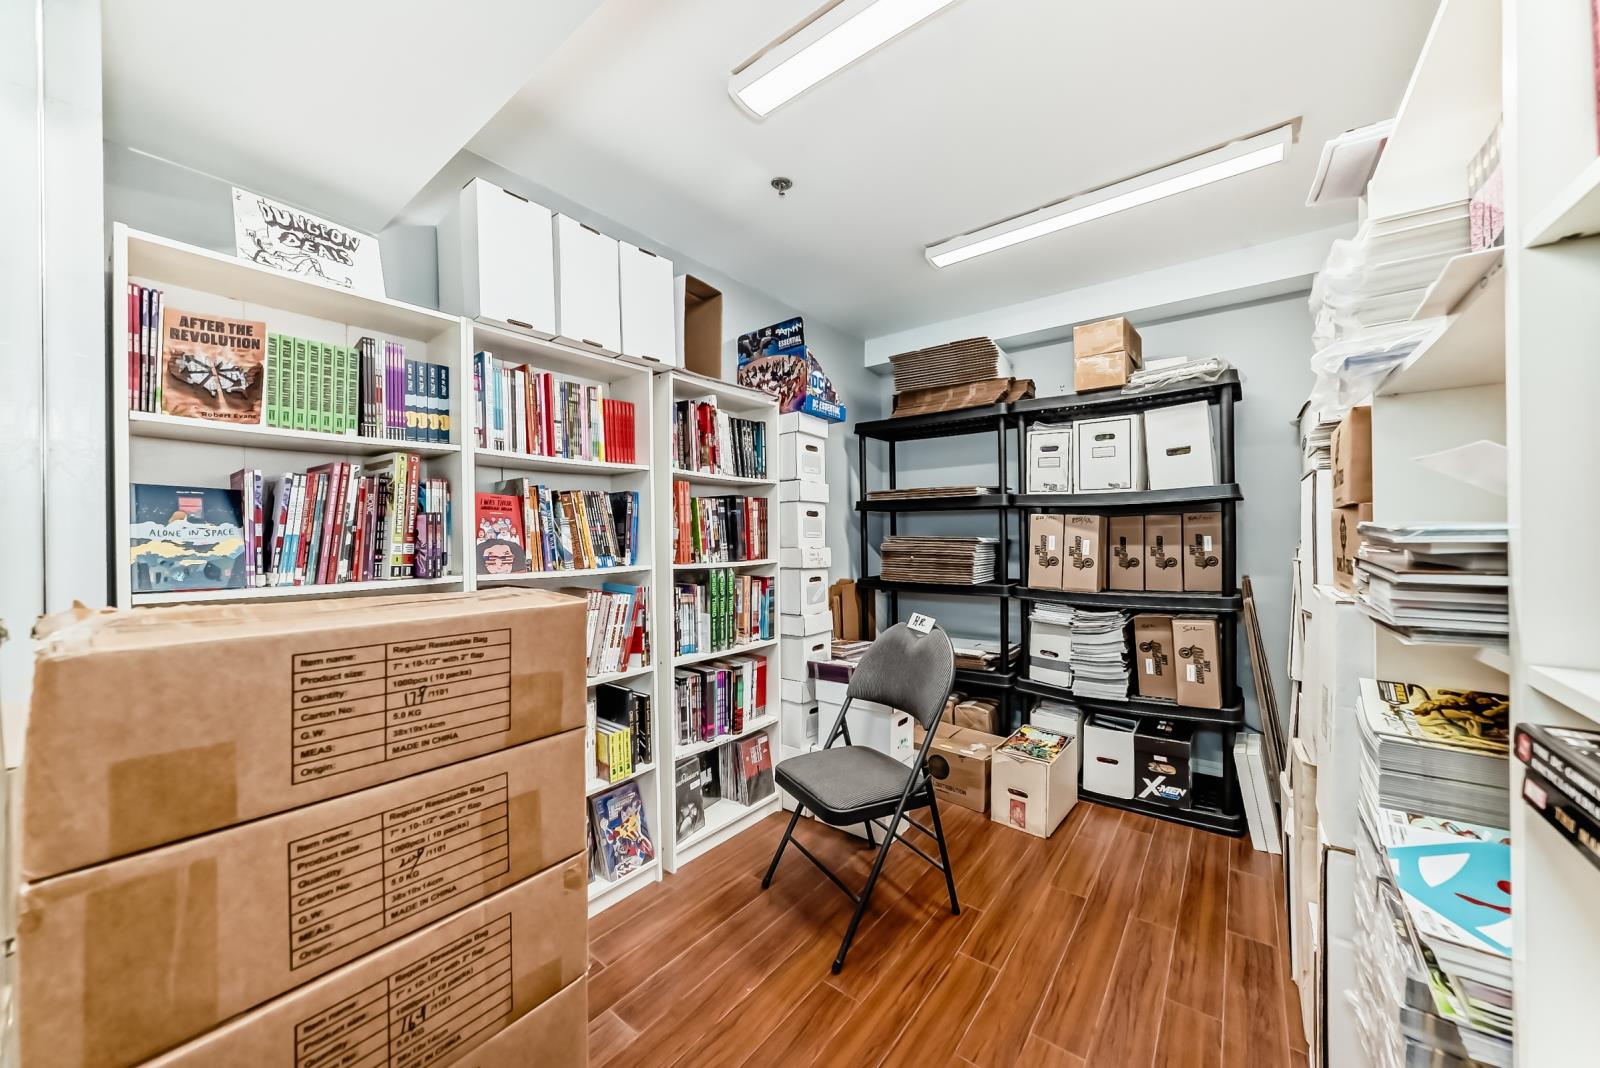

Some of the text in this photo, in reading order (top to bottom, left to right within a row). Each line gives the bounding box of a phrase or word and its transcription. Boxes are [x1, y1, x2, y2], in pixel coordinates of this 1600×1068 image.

[257, 199, 360, 252] DUNGEON
[278, 231, 353, 267] DEALS
[179, 315, 254, 336] AFTER THE
[169, 327, 260, 349] REVOLUTION
[811, 373, 826, 389] DC
[201, 411, 231, 419] Robert
[408, 483, 417, 534] BLACK HAMMER
[149, 529, 181, 538] ALONE
[203, 528, 235, 537] SPACE
[392, 636, 488, 653] Regular Resealable Bag
[300, 654, 356, 667] Item name:
[442, 655, 459, 663] with
[300, 669, 366, 685] Product size:
[393, 676, 428, 687] 1000pcs
[435, 671, 444, 680] 10
[300, 690, 347, 704] Quantity:
[300, 706, 355, 722] Carton No:
[393, 709, 421, 720] 5.0 KG
[300, 744, 335, 759] MEAS:
[391, 732, 458, 754] MADE IN CHINA
[300, 763, 336, 777] Origin:
[1138, 775, 1187, 799] X-MEN
[389, 806, 423, 820] Regular
[469, 785, 485, 794] Bag
[439, 810, 456, 820] with
[296, 829, 352, 852] Item name:
[297, 851, 338, 870] Product
[298, 889, 334, 907] Carton
[390, 885, 457, 919] MADE IN CHINA
[298, 922, 334, 942] MEAS:
